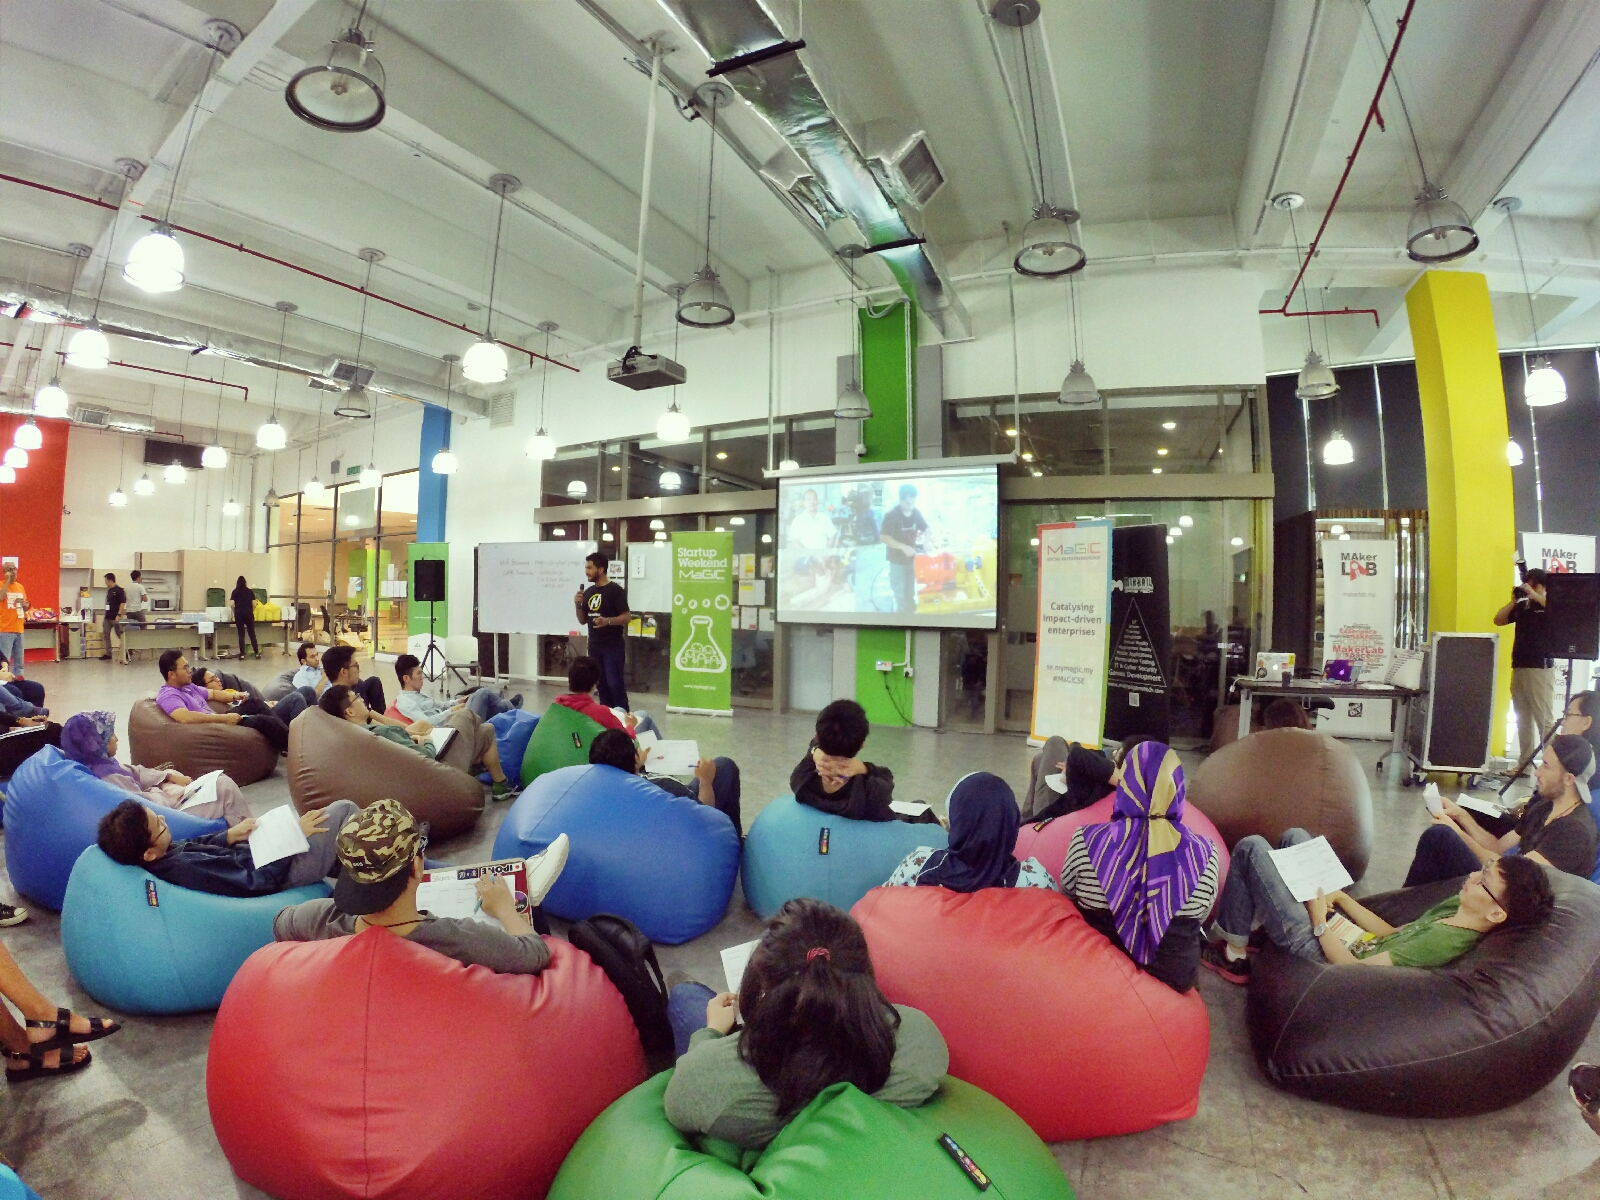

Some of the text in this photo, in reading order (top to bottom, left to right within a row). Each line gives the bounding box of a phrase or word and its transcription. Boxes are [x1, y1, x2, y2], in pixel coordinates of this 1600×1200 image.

[678, 548, 717, 559] Startup
[1047, 543, 1101, 555] MaGIC
[1542, 548, 1577, 559] MAker
[1341, 553, 1377, 561] MAker
[678, 558, 728, 568] Weekend
[679, 570, 726, 580] MaGIC
[1050, 602, 1095, 613] Catalysing
[1043, 614, 1102, 624] impact-driven
[1048, 627, 1096, 637] enterprises
[1332, 645, 1384, 654] MakerLab
[1047, 664, 1094, 675] se.mymagic.my
[1126, 671, 1162, 682] Development
